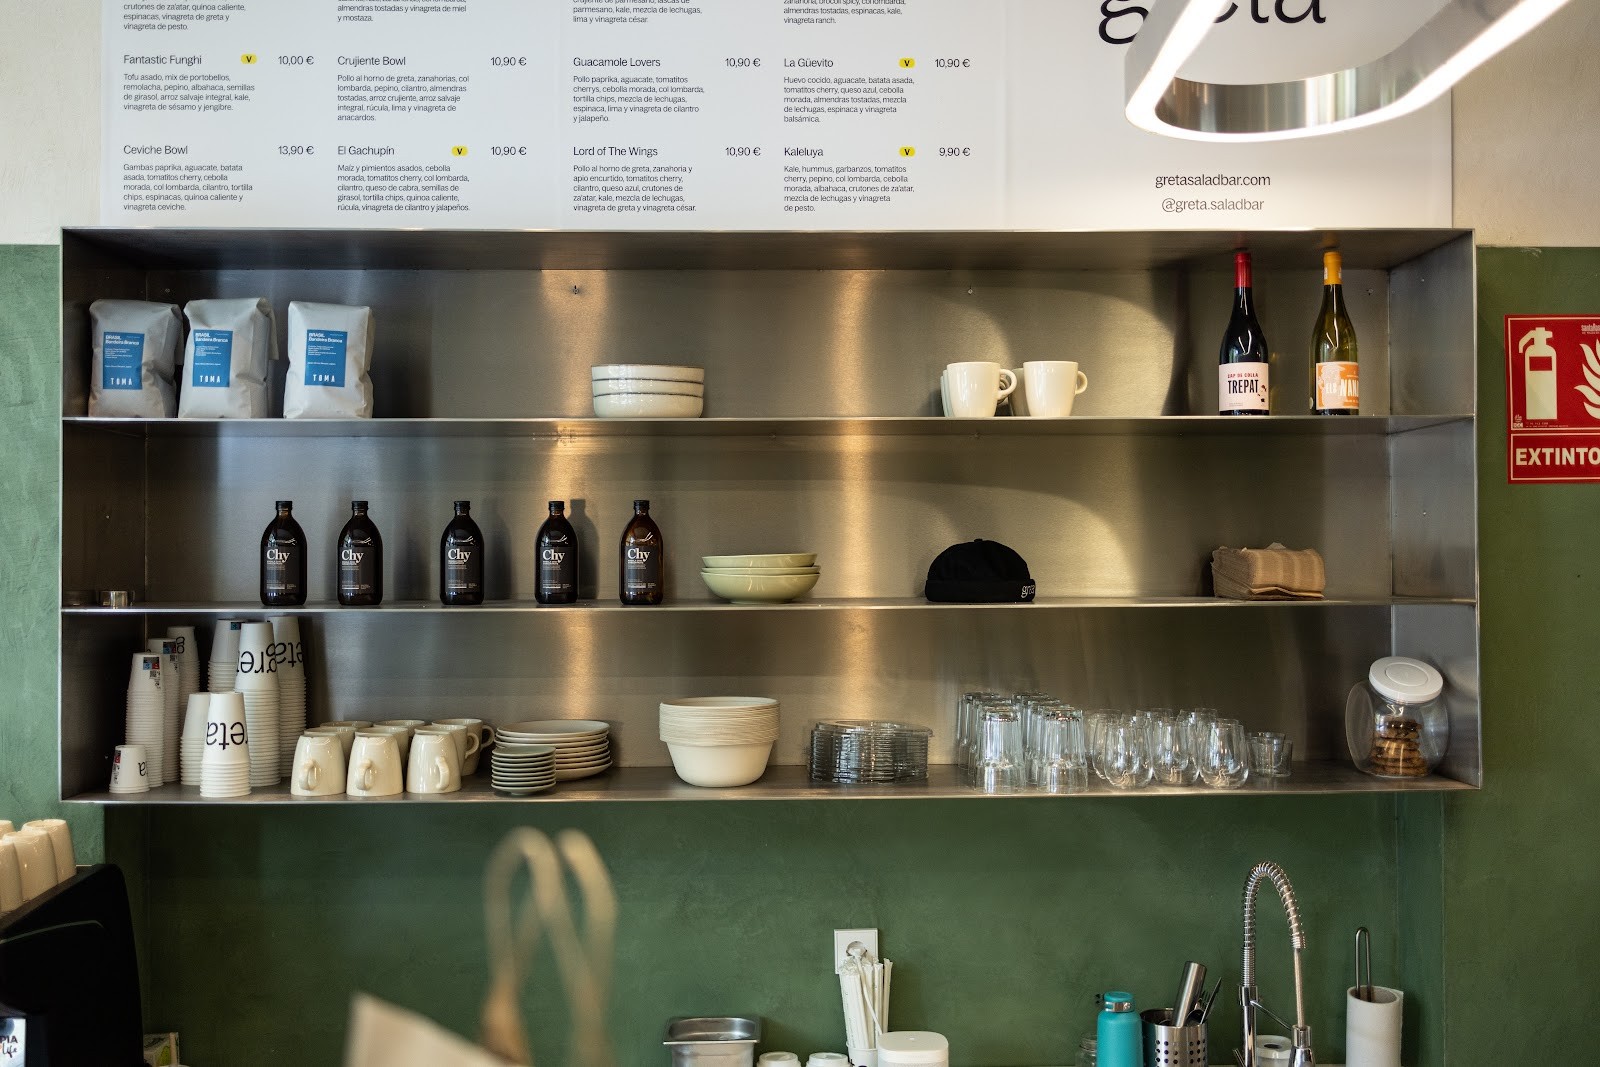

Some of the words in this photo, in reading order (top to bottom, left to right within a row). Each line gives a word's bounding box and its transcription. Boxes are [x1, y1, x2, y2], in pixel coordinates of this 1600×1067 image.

[784, 17, 815, 25] vinagreta
[124, 55, 167, 64] Fantastic
[169, 55, 202, 66] Funghi
[278, 56, 304, 67] 10,00
[306, 56, 314, 65] €
[337, 56, 380, 67] Crujiente
[382, 57, 406, 65] Bowl
[491, 57, 516, 66] 10,90
[518, 57, 526, 66] €
[573, 58, 628, 66] Guacamole
[630, 58, 660, 66] Lovers
[725, 58, 750, 68] 10,90
[752, 58, 760, 67] €
[784, 59, 796, 67] La
[798, 58, 834, 67] Güevito
[935, 58, 960, 68] 10,90
[962, 58, 970, 68] €
[573, 86, 601, 94] cherrys,
[437, 95, 461, 103] salvaje
[578, 115, 610, 123] jalapeño.
[123, 145, 162, 154] Ceviche
[164, 146, 188, 154] Bowl
[278, 146, 304, 156] 13,90
[306, 146, 314, 154] €
[337, 146, 346, 155] El
[348, 146, 395, 156] Gachupín
[491, 147, 516, 156] 10,90
[518, 147, 526, 155] €
[573, 147, 595, 155] Lord
[597, 147, 606, 155] of
[608, 147, 626, 155] The
[628, 147, 658, 157] Wings
[726, 147, 751, 158] 10,90
[753, 147, 761, 156] €
[784, 148, 824, 158] Kaleluya
[939, 148, 960, 157] 9,90
[962, 148, 970, 156] €
[179, 174, 202, 182] cherry,
[660, 175, 683, 183] cherry,
[1155, 174, 1271, 188] gretasaladbar.com
[1161, 198, 1265, 213] @greta.saladbar
[1228, 380, 1258, 394] TREPAT
[267, 549, 290, 563] Chy
[342, 549, 364, 563] Chy
[448, 549, 471, 562] Chy
[542, 548, 565, 562] Chy
[627, 548, 650, 562] Chy
